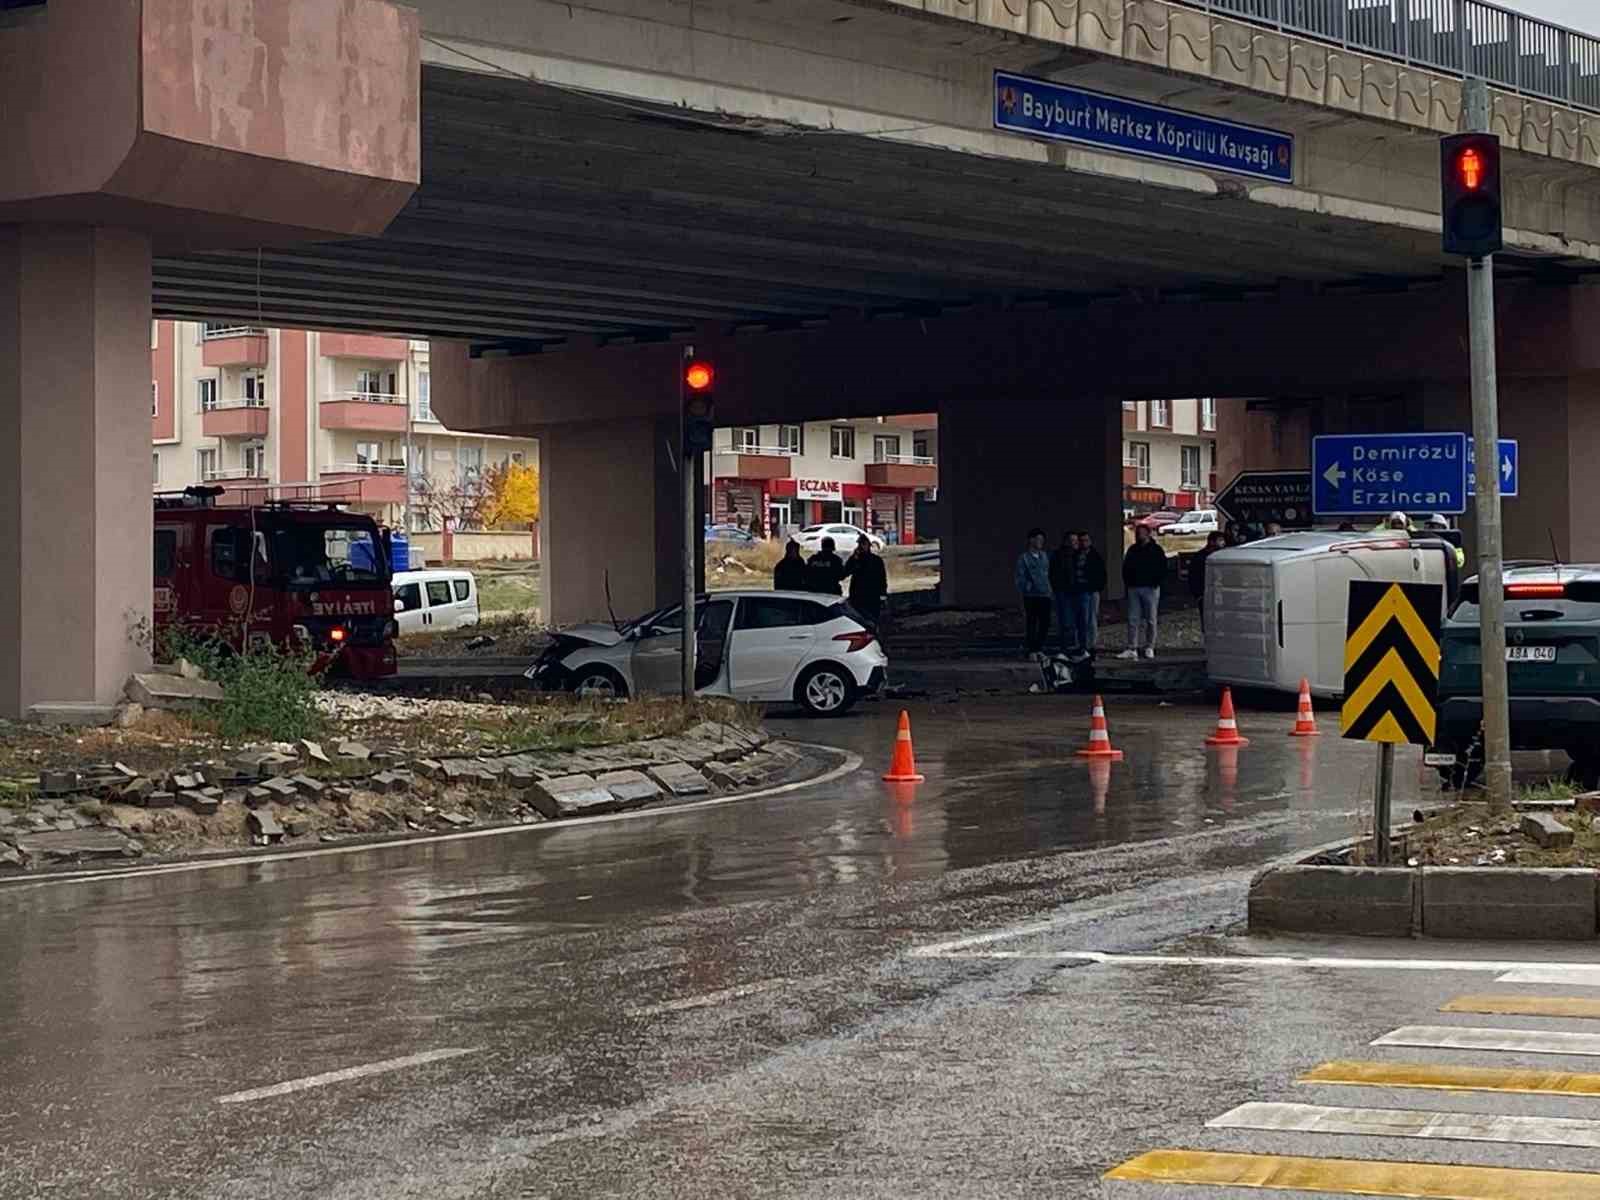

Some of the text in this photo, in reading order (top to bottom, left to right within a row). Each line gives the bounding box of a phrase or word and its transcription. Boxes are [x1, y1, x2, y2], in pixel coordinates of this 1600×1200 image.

[1022, 92, 1274, 169] Bayburt Merkez Köprülü Kavşağı
[1353, 444, 1457, 461] Demirözü
[1353, 467, 1404, 483] Köse
[799, 480, 840, 492] ECZANE
[1353, 489, 1450, 505] Erzincan
